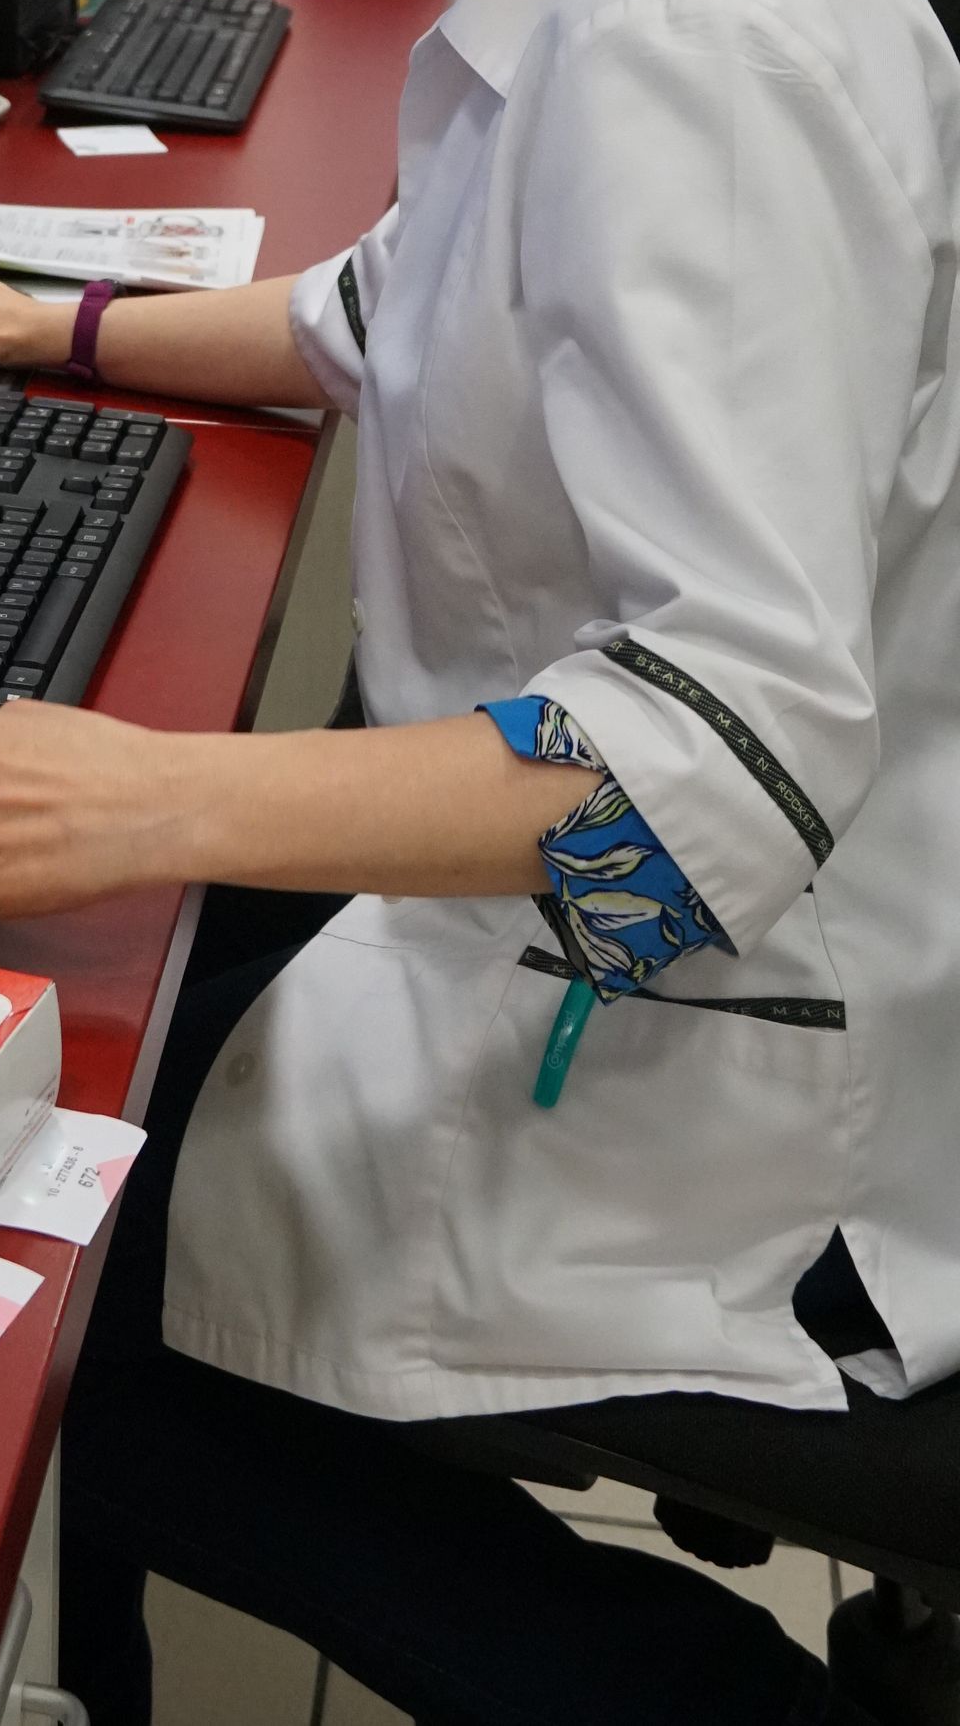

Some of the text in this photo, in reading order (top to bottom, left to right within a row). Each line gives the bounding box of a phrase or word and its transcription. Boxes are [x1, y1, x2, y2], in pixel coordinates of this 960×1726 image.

[635, 654, 702, 702] SKATE
[776, 781, 819, 834] ROCKET
[78, 1166, 101, 1188] 672
